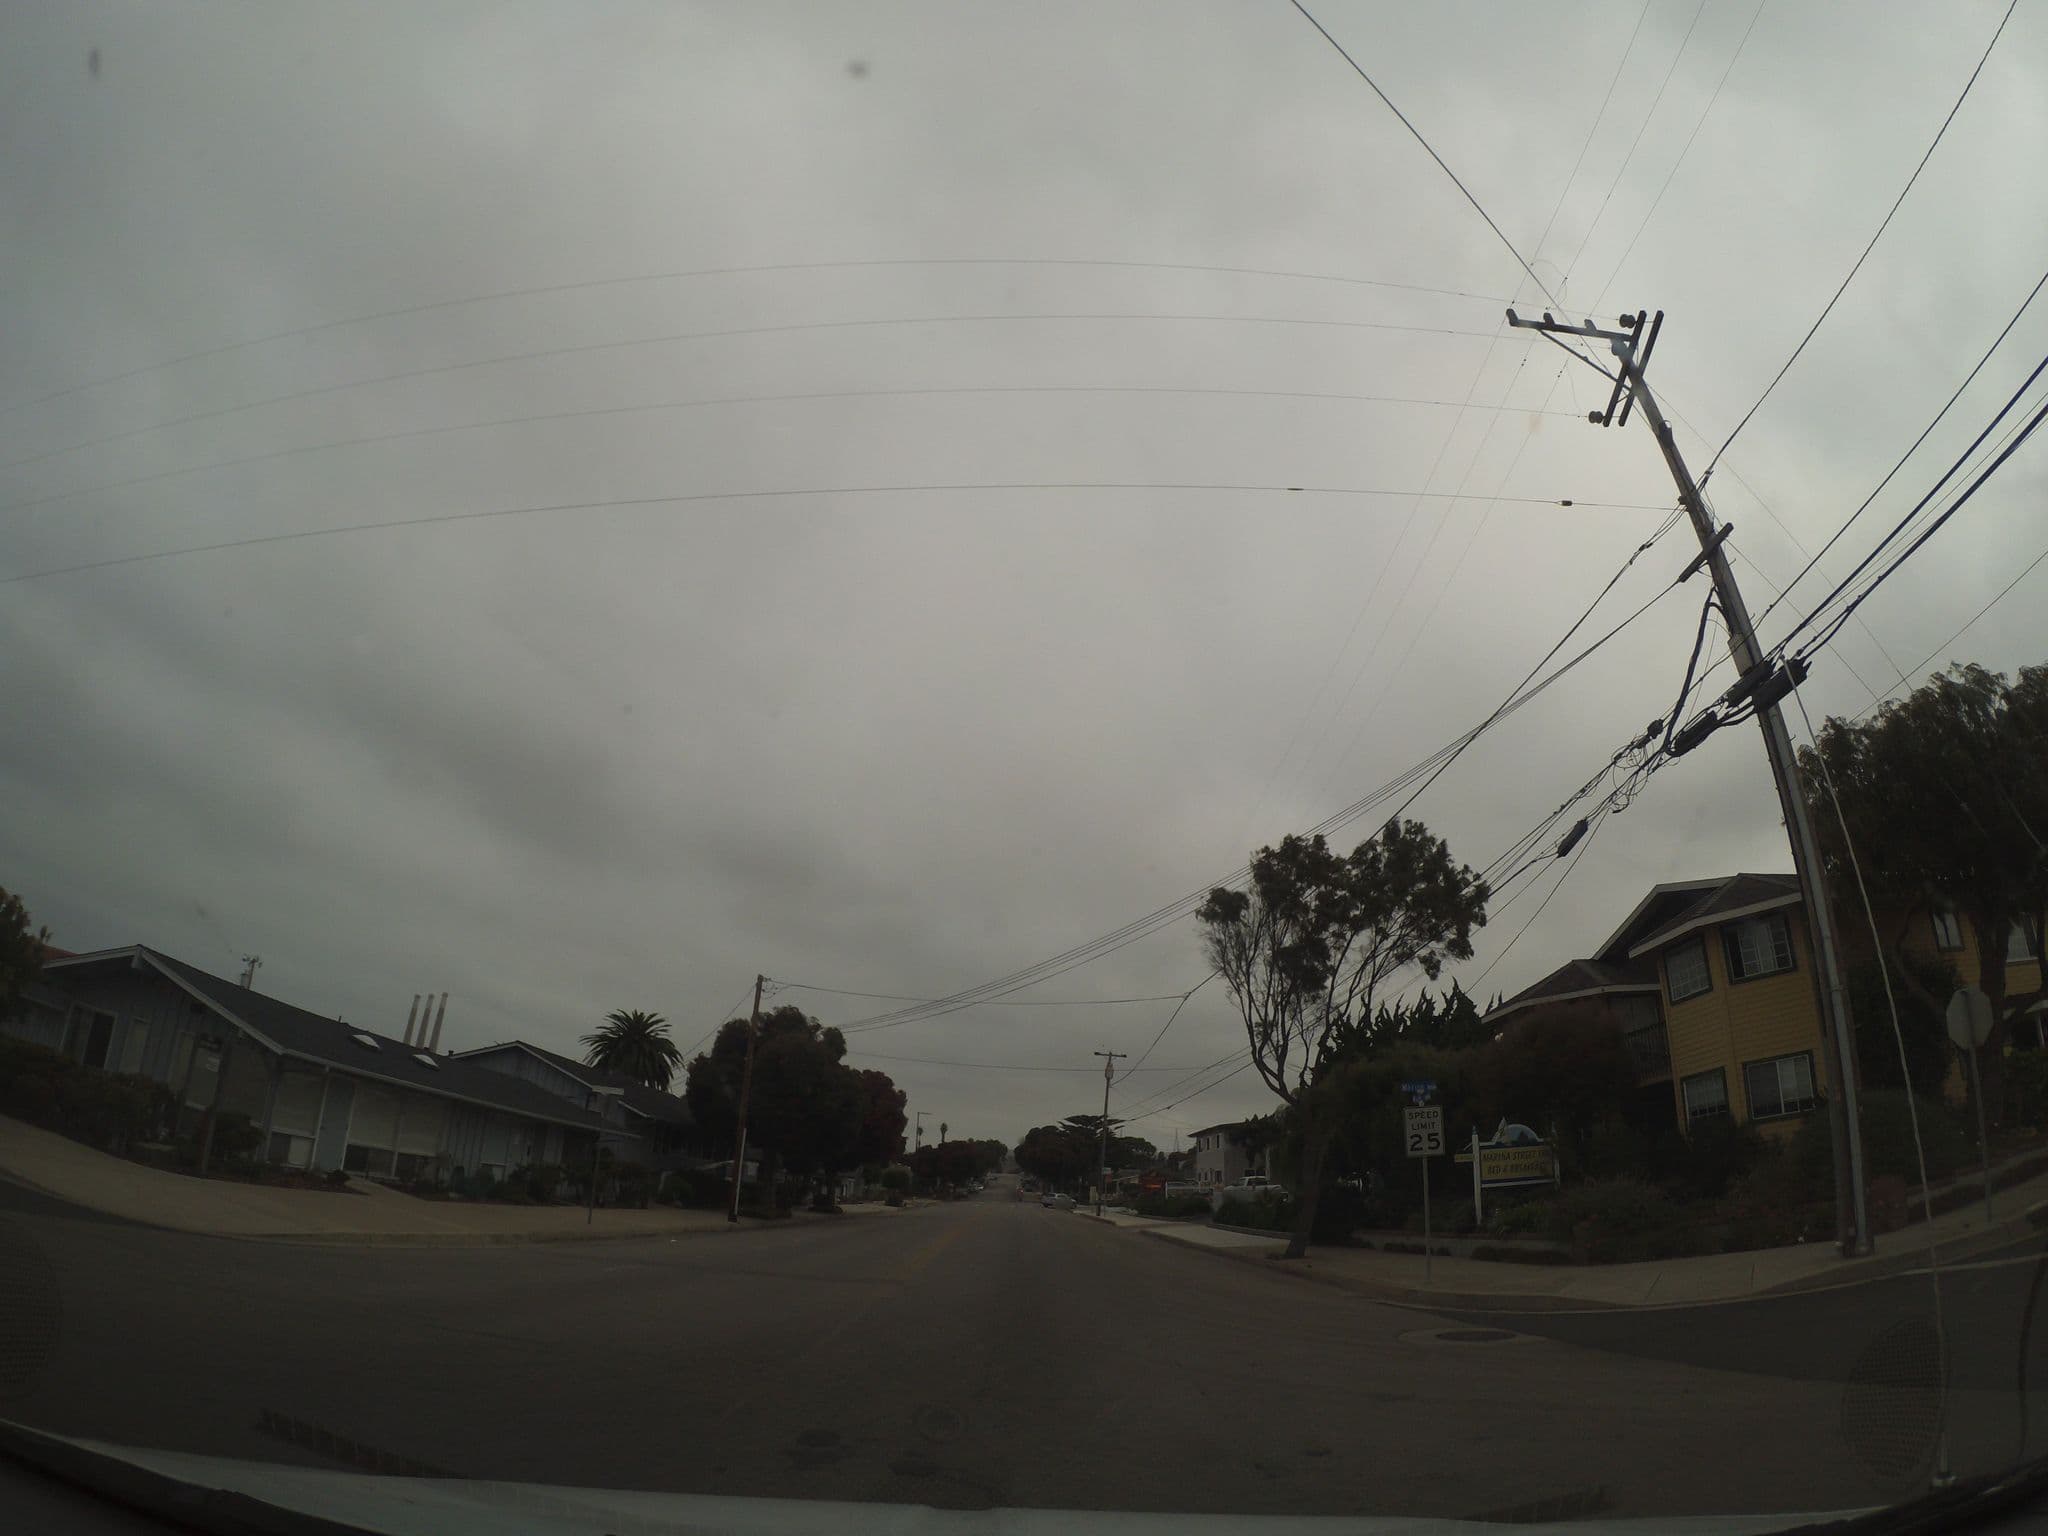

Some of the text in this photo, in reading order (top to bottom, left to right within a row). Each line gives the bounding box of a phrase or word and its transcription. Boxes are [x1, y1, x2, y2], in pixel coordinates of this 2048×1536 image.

[1408, 1110, 1438, 1120] SPEED
[1411, 1121, 1435, 1130] LIMIT
[1410, 1132, 1440, 1151] 25
